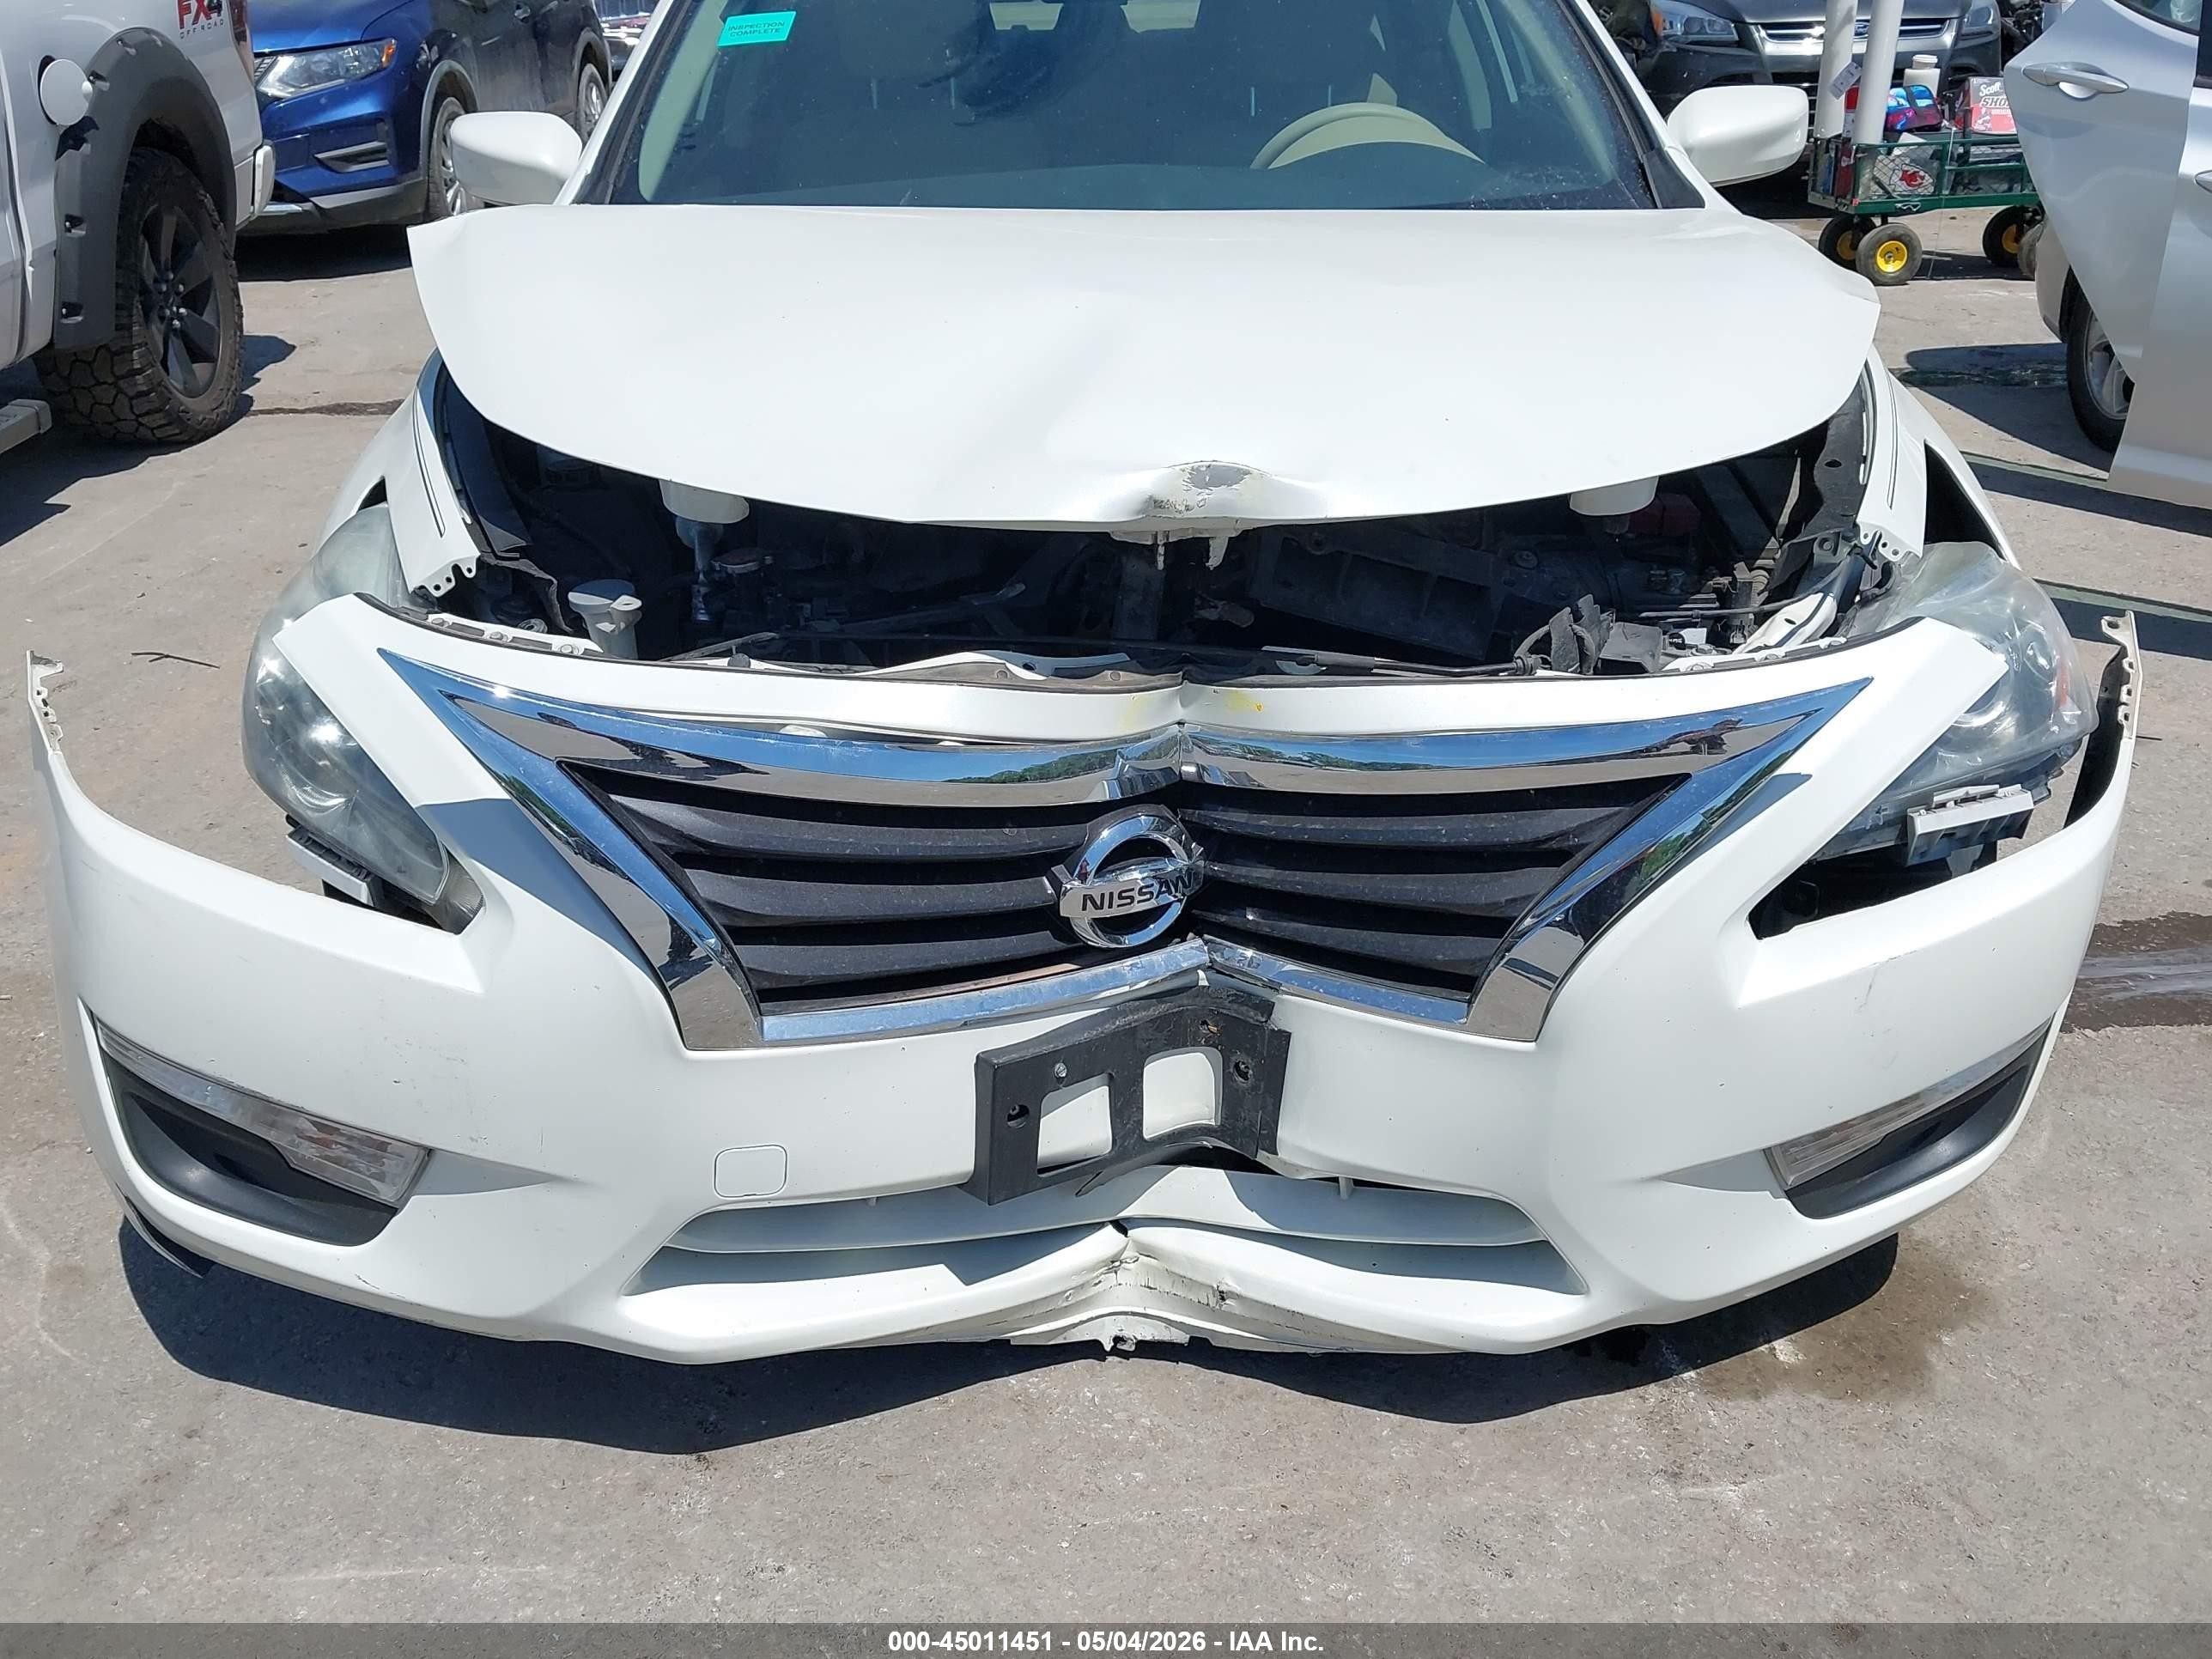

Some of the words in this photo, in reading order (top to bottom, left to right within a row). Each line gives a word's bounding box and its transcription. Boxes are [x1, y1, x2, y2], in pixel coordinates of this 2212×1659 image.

[178, 0, 222, 29] FX4
[727, 21, 786, 32] INSPECTION
[729, 27, 781, 38] COMPLETE
[1978, 81, 2002, 97] Scott
[1981, 96, 2009, 107] SHO
[1081, 872, 1194, 912] NISSAN
